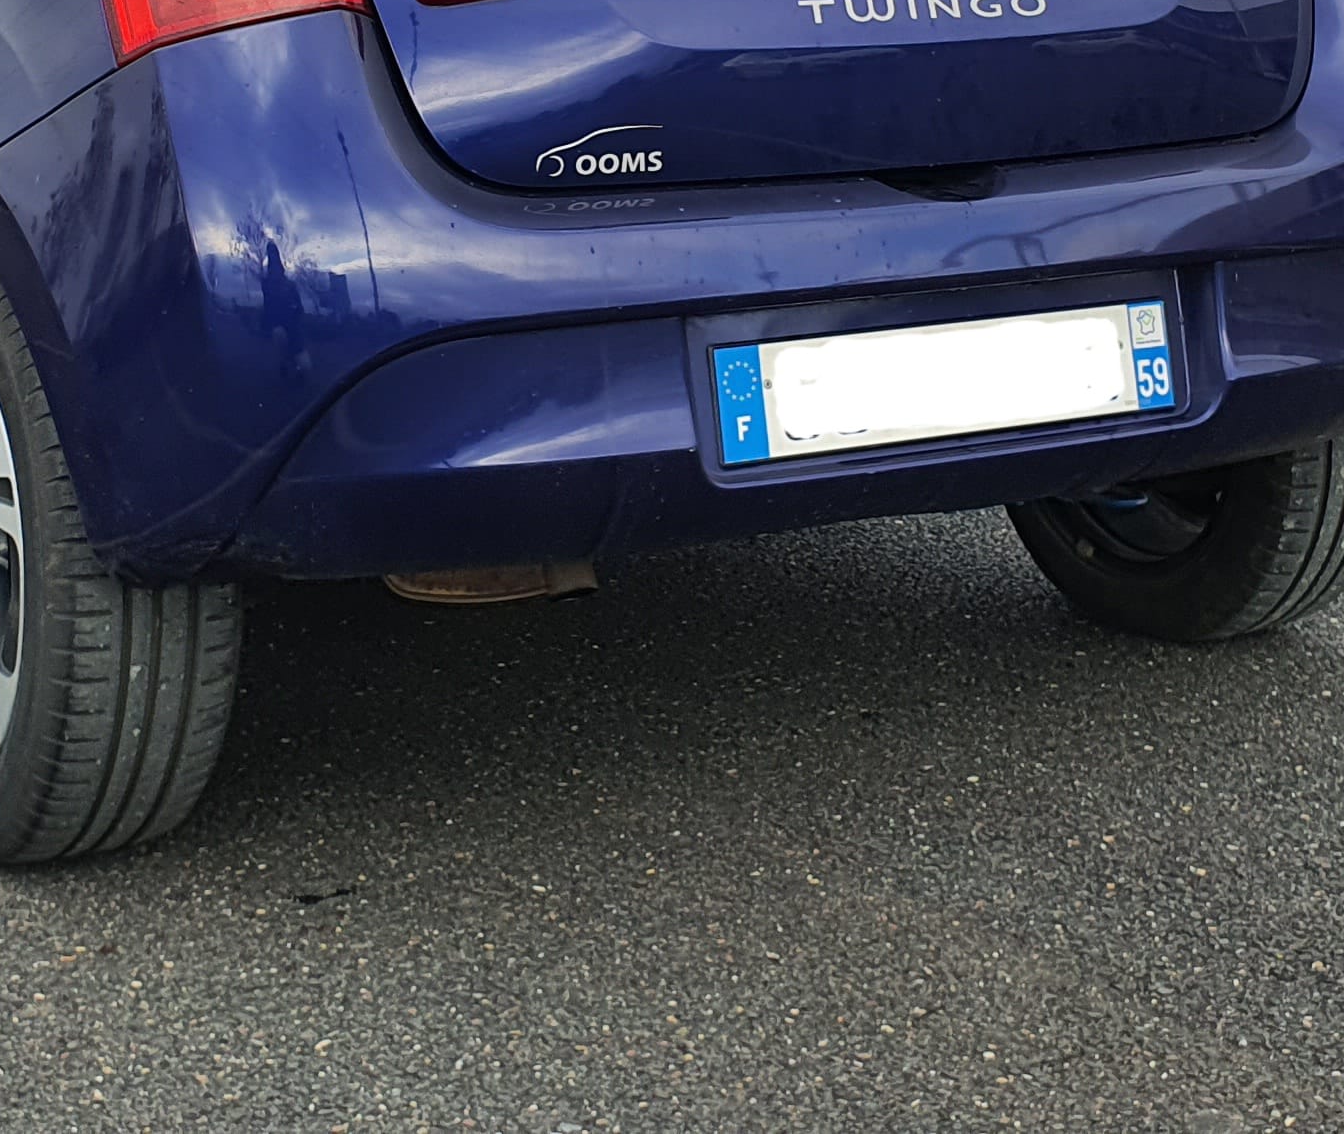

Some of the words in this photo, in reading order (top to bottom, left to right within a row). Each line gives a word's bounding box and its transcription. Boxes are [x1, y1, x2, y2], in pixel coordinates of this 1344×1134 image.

[575, 151, 663, 176] OOMS
[1136, 356, 1170, 398] 59
[736, 415, 752, 442] F
